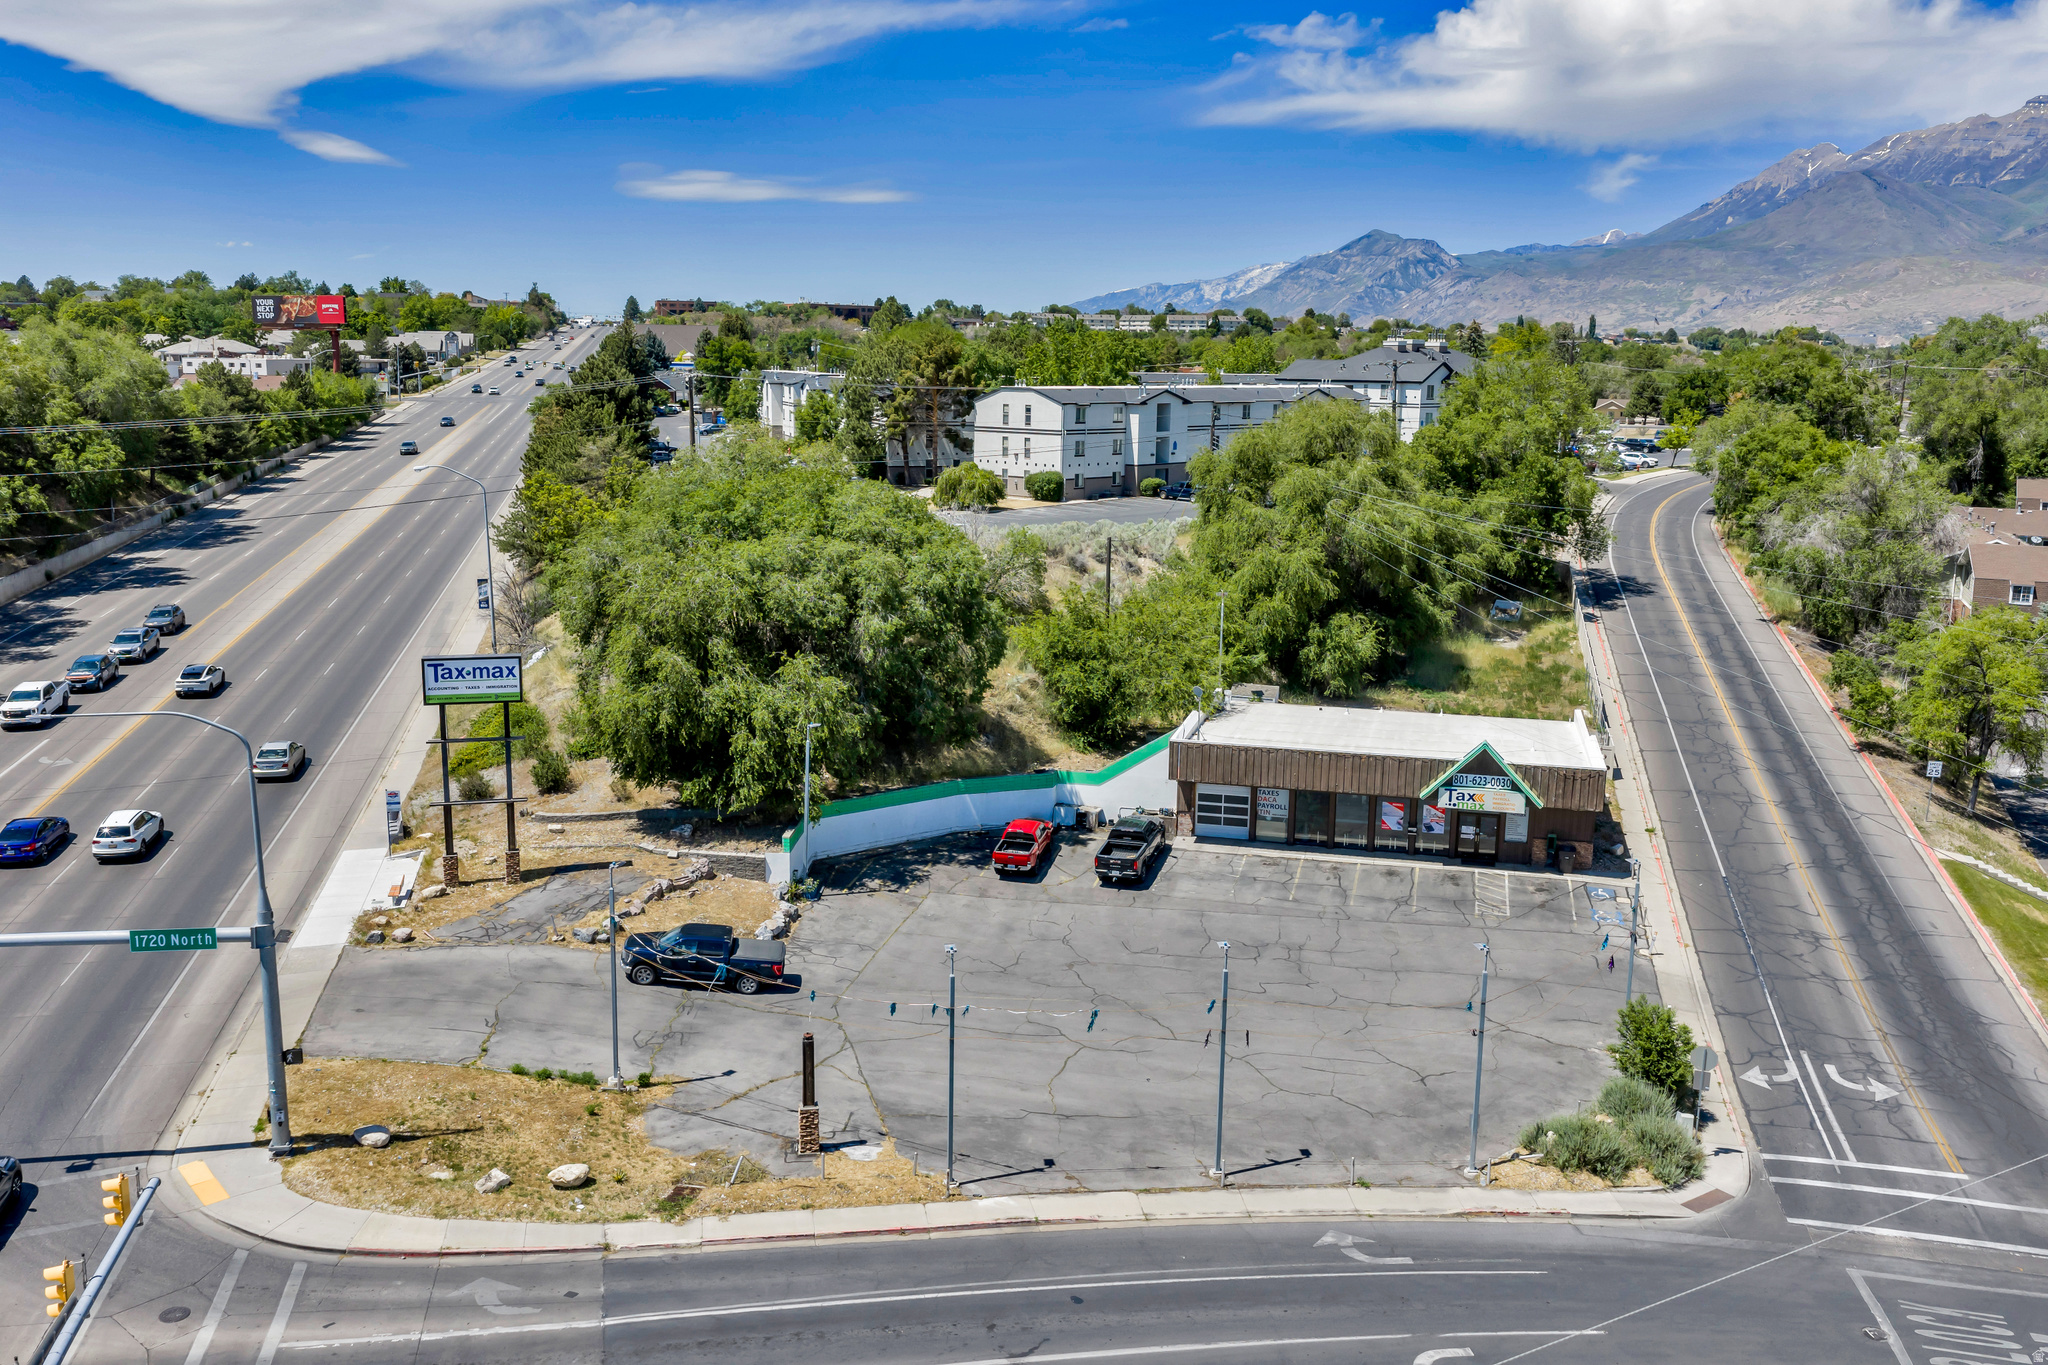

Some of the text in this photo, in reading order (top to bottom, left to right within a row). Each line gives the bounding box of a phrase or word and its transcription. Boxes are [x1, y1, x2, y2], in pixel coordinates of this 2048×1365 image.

[1453, 774, 1511, 788] 801-623-0030
[1444, 788, 1476, 802] Tax
[1457, 802, 1485, 810] max
[135, 933, 212, 947] 1720 North
